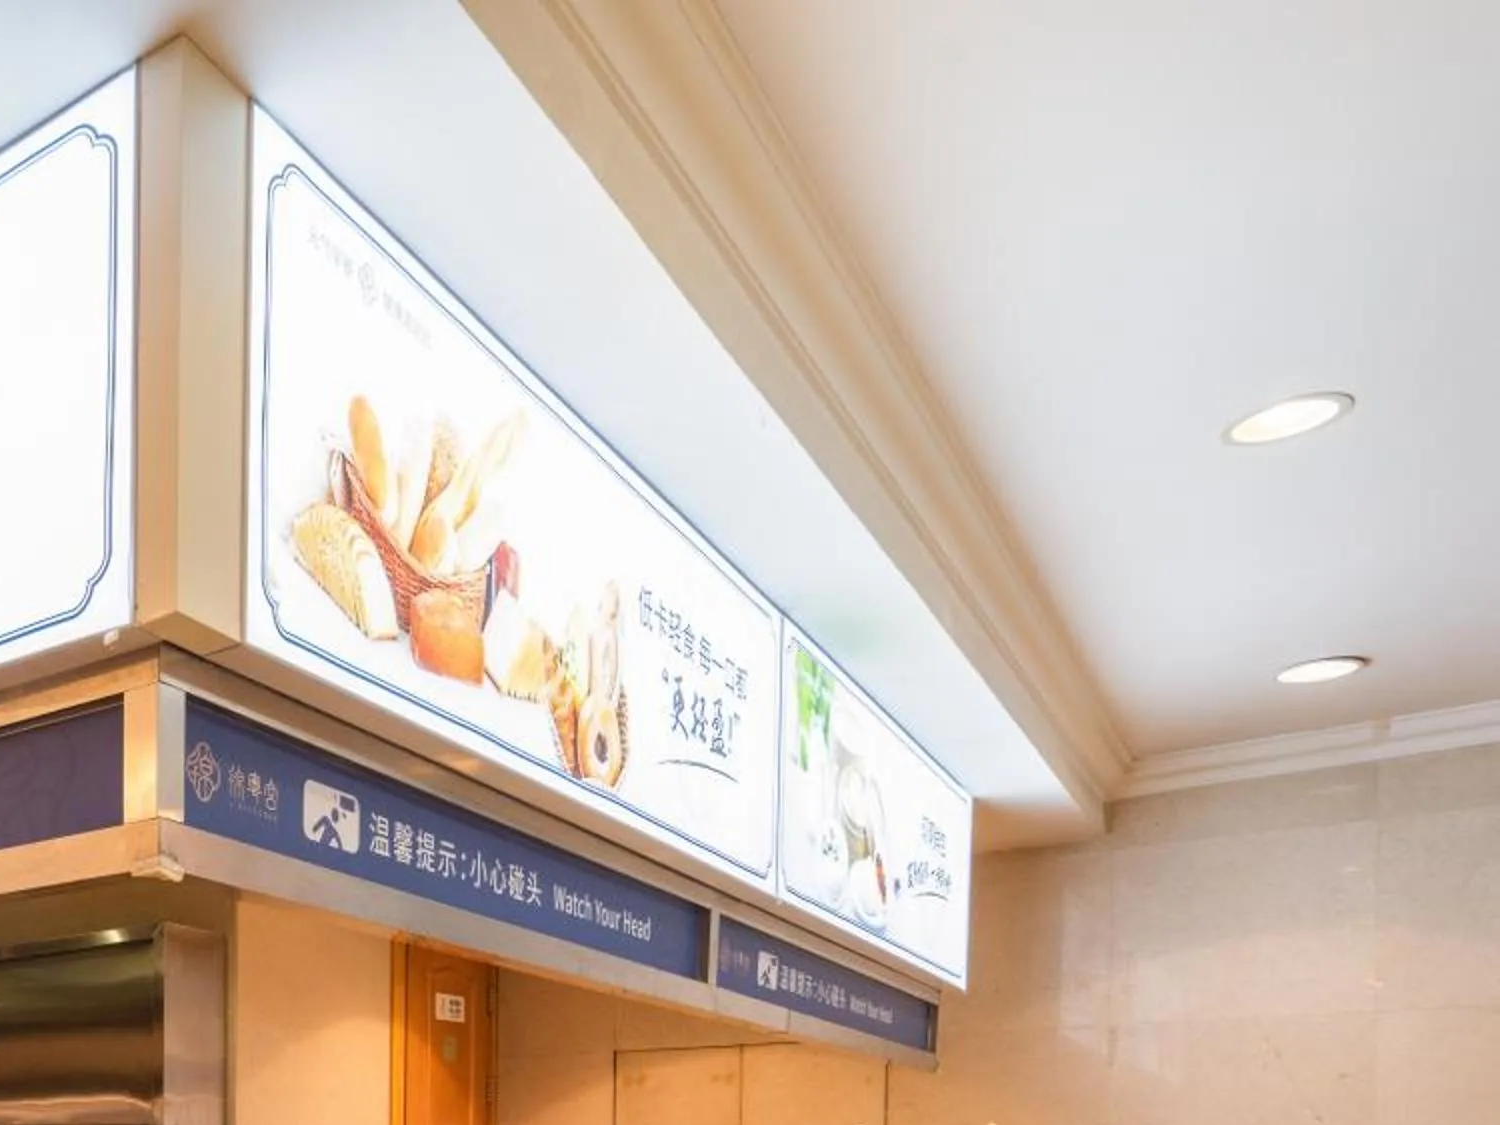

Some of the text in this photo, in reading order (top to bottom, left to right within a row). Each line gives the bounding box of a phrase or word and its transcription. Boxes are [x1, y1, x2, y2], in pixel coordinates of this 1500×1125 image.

[369, 812, 651, 941] 温馨提示:小心碰头 Watch Your Head
